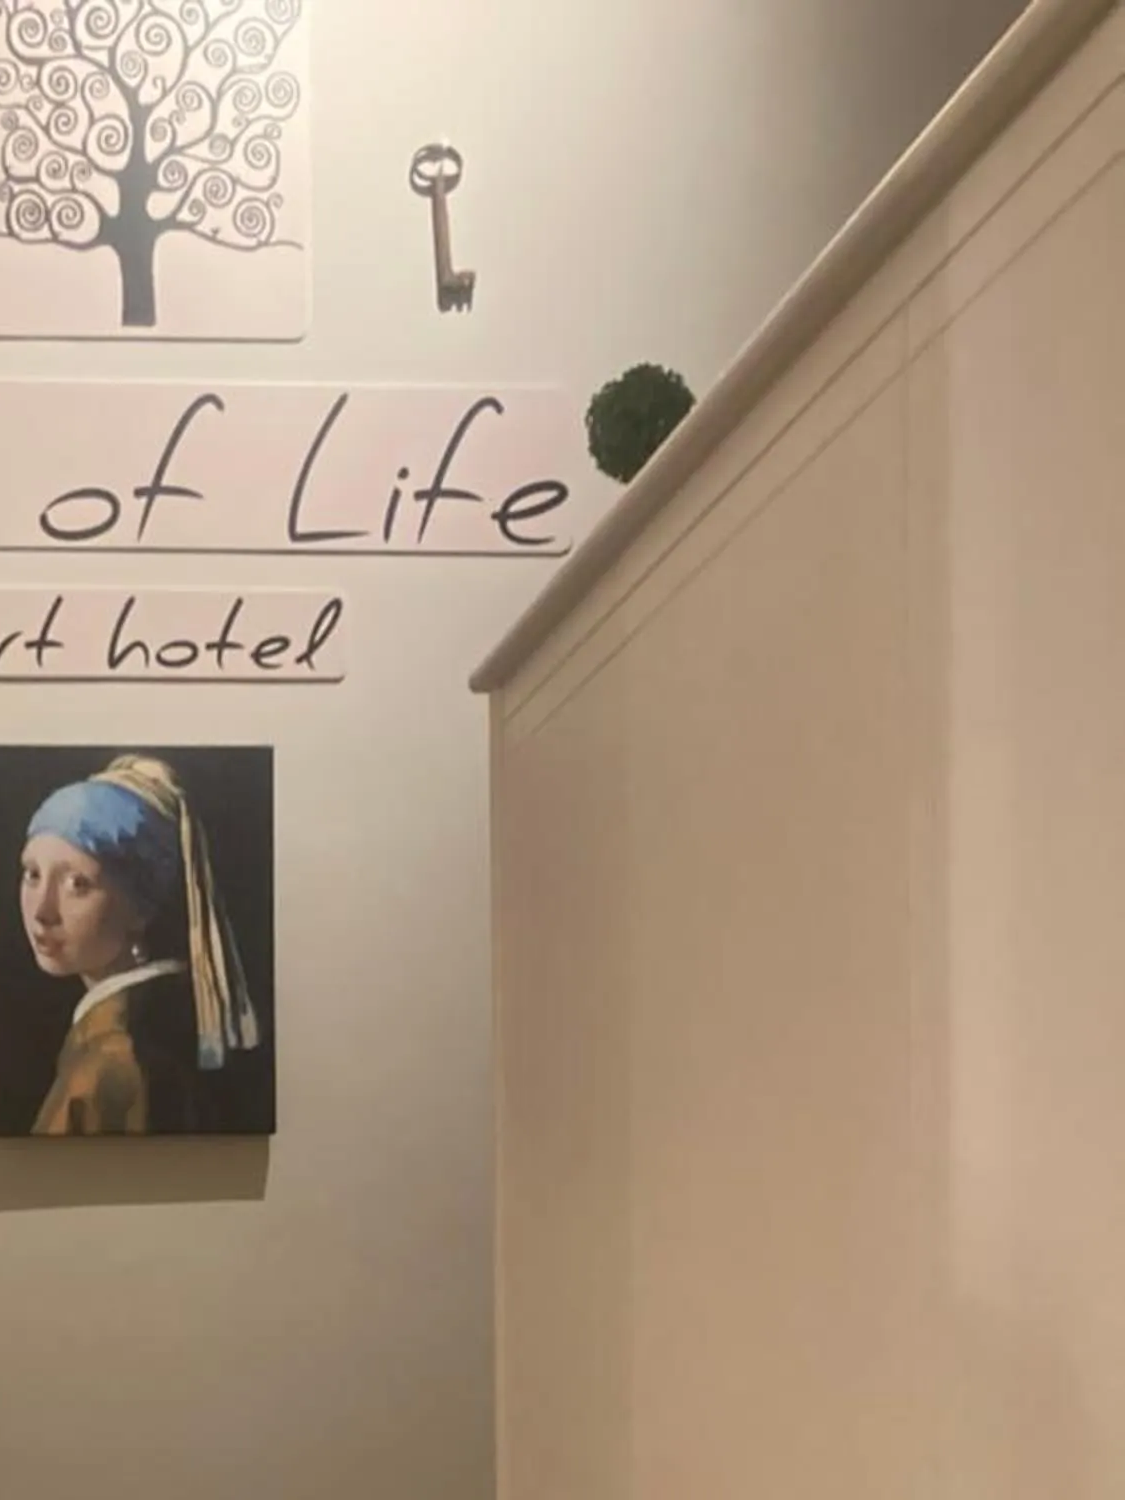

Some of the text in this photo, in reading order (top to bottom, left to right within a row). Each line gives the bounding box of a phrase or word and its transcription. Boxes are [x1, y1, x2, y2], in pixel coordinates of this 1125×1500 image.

[39, 392, 225, 542] of
[287, 393, 571, 547] Life
[107, 597, 343, 670] hotel
